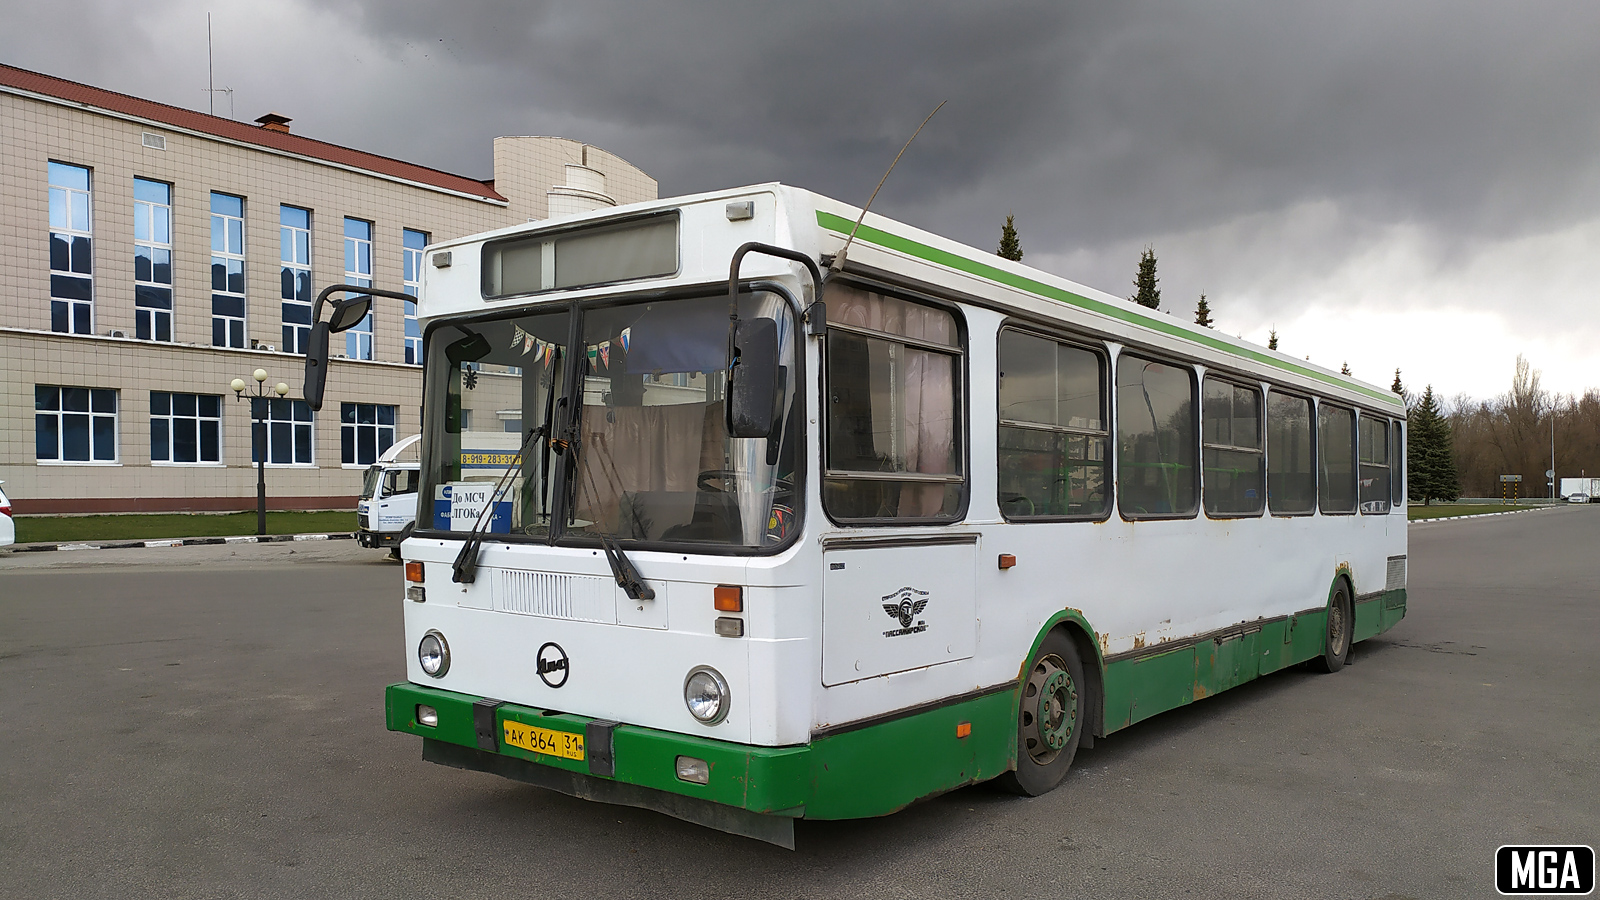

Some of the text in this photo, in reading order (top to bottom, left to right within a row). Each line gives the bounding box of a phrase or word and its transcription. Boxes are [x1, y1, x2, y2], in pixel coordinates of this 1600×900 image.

[452, 493, 463, 504] До
[464, 492, 485, 503] МСЧ
[452, 508, 480, 519] ЛГОКа
[530, 731, 556, 752] 864
[564, 735, 578, 751] 31
